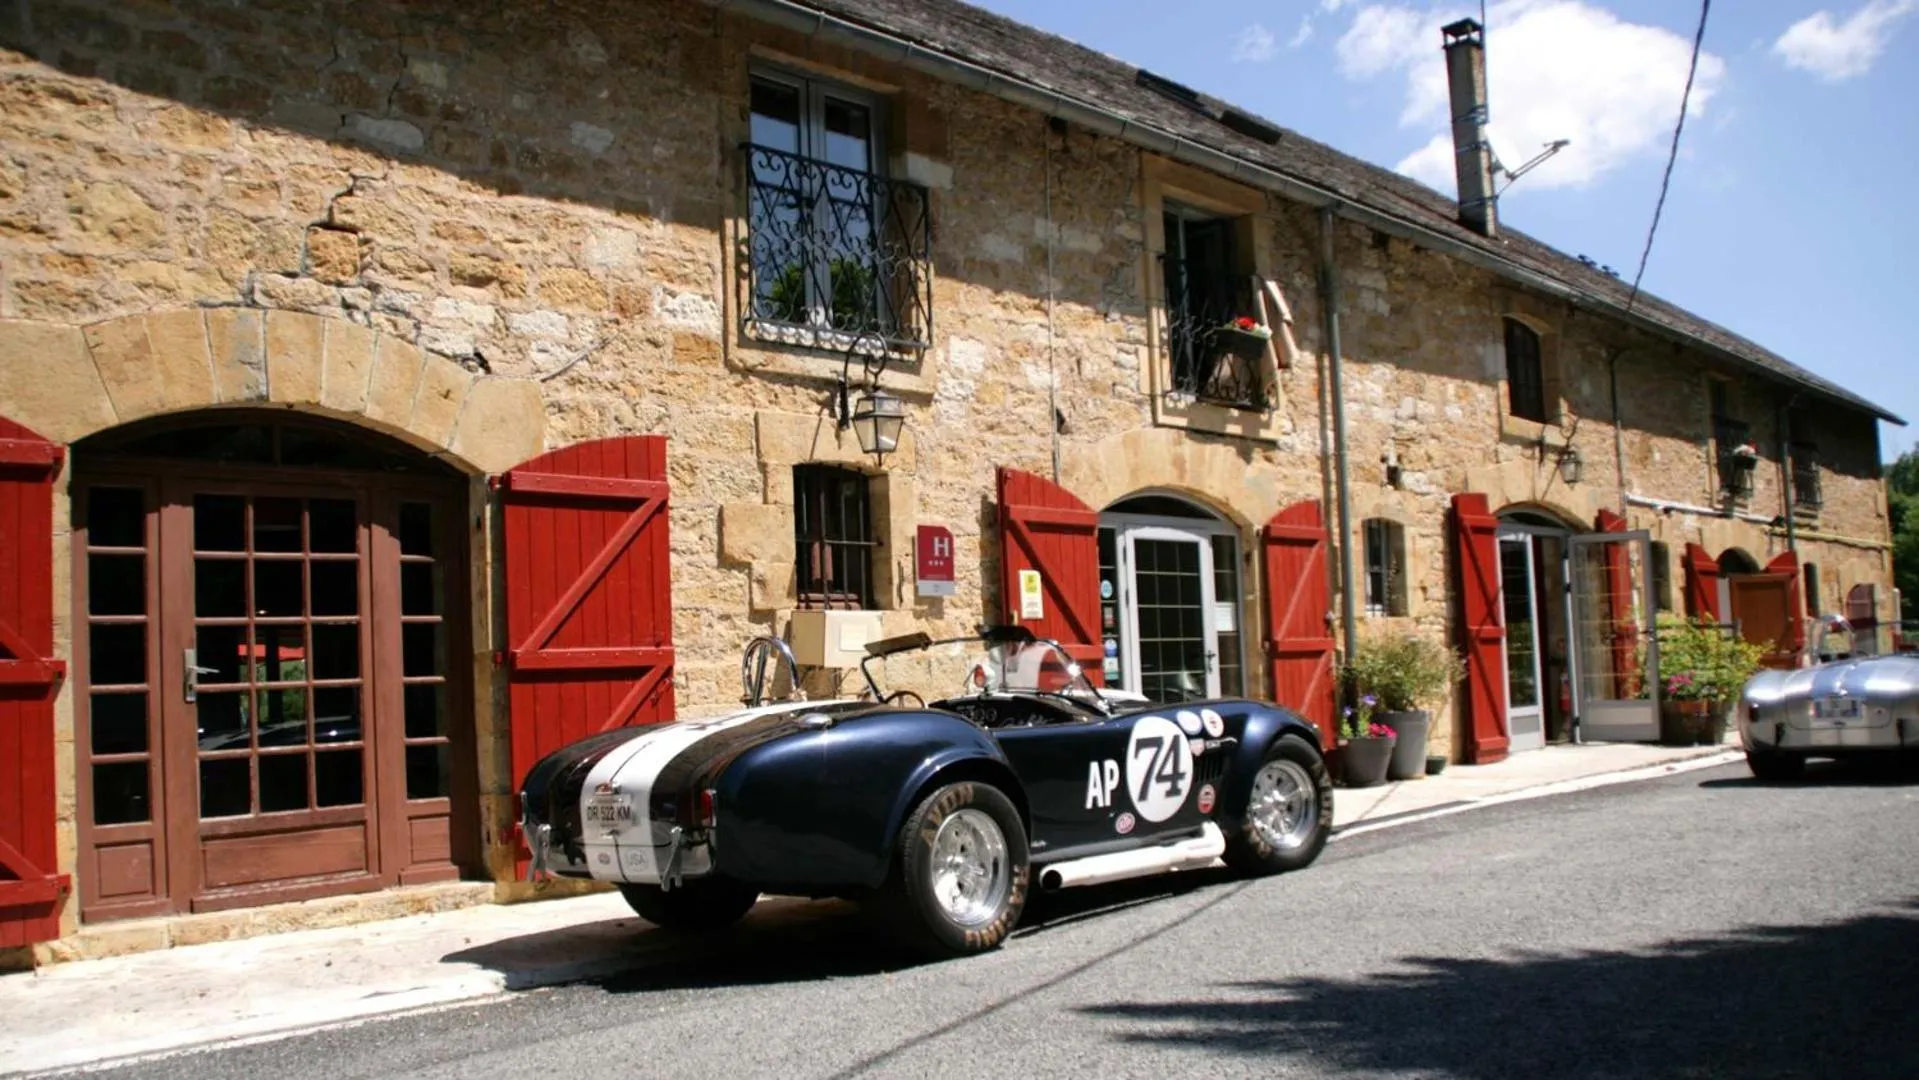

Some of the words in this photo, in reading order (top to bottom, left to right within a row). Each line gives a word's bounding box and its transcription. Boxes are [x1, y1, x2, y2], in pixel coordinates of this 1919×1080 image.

[934, 536, 949, 557] H
[1085, 759, 1120, 809] AP
[1134, 734, 1187, 802] 74
[586, 806, 599, 821] DR
[601, 806, 615, 821] 522
[617, 805, 631, 820] KM
